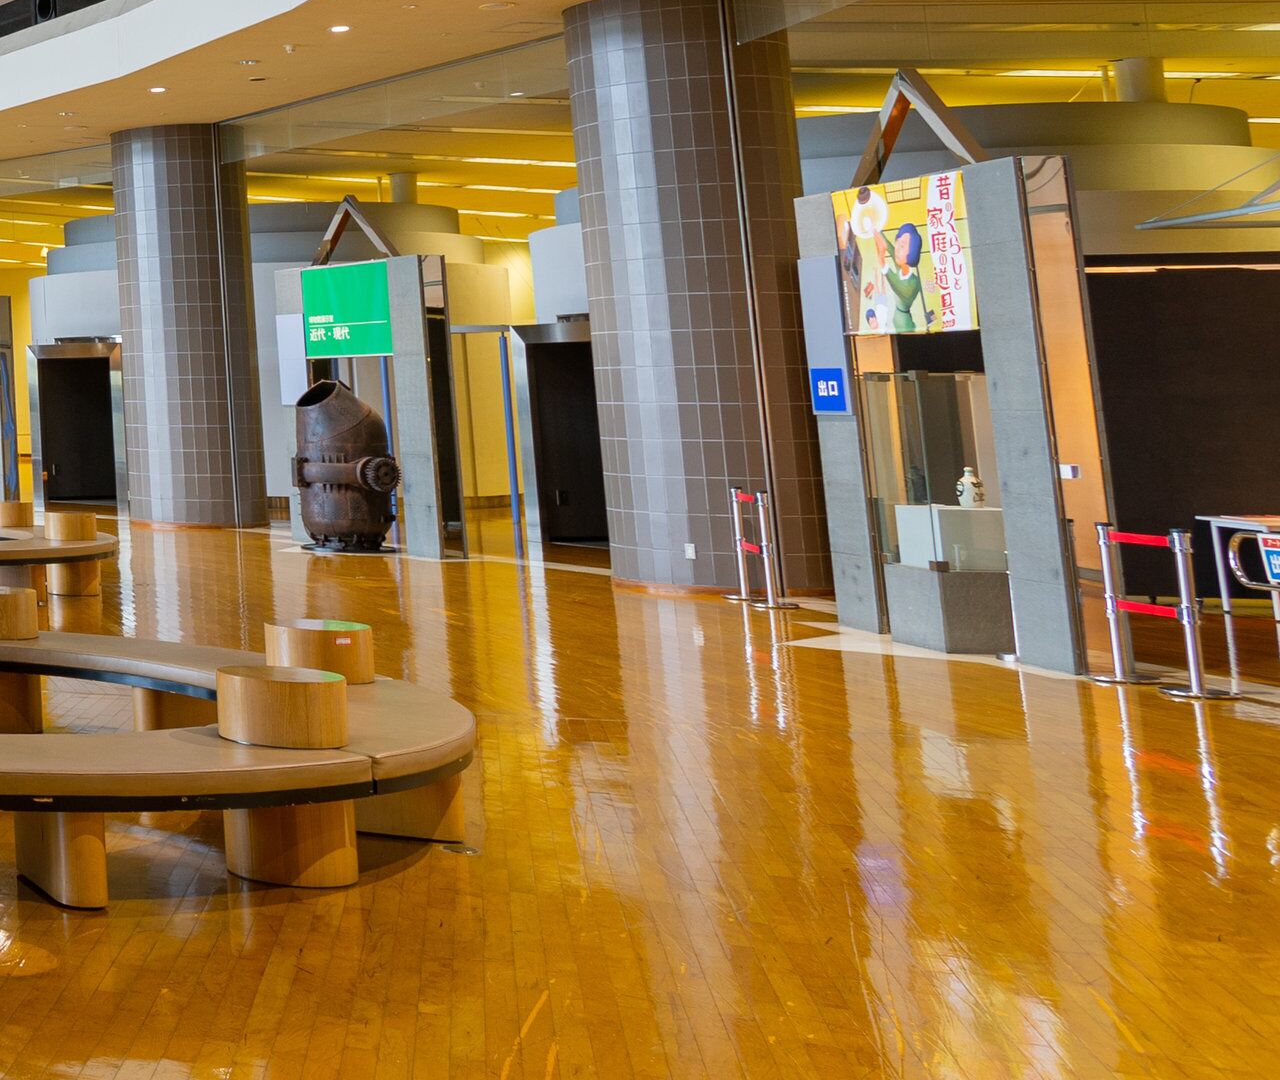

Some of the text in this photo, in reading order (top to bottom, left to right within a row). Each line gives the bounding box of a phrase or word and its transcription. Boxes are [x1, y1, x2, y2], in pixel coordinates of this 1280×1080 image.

[927, 206, 956, 316] 家庭の道具
[936, 175, 963, 290] 昔のくらしと
[309, 327, 350, 341] 近代・現代
[817, 380, 839, 396] 出口
